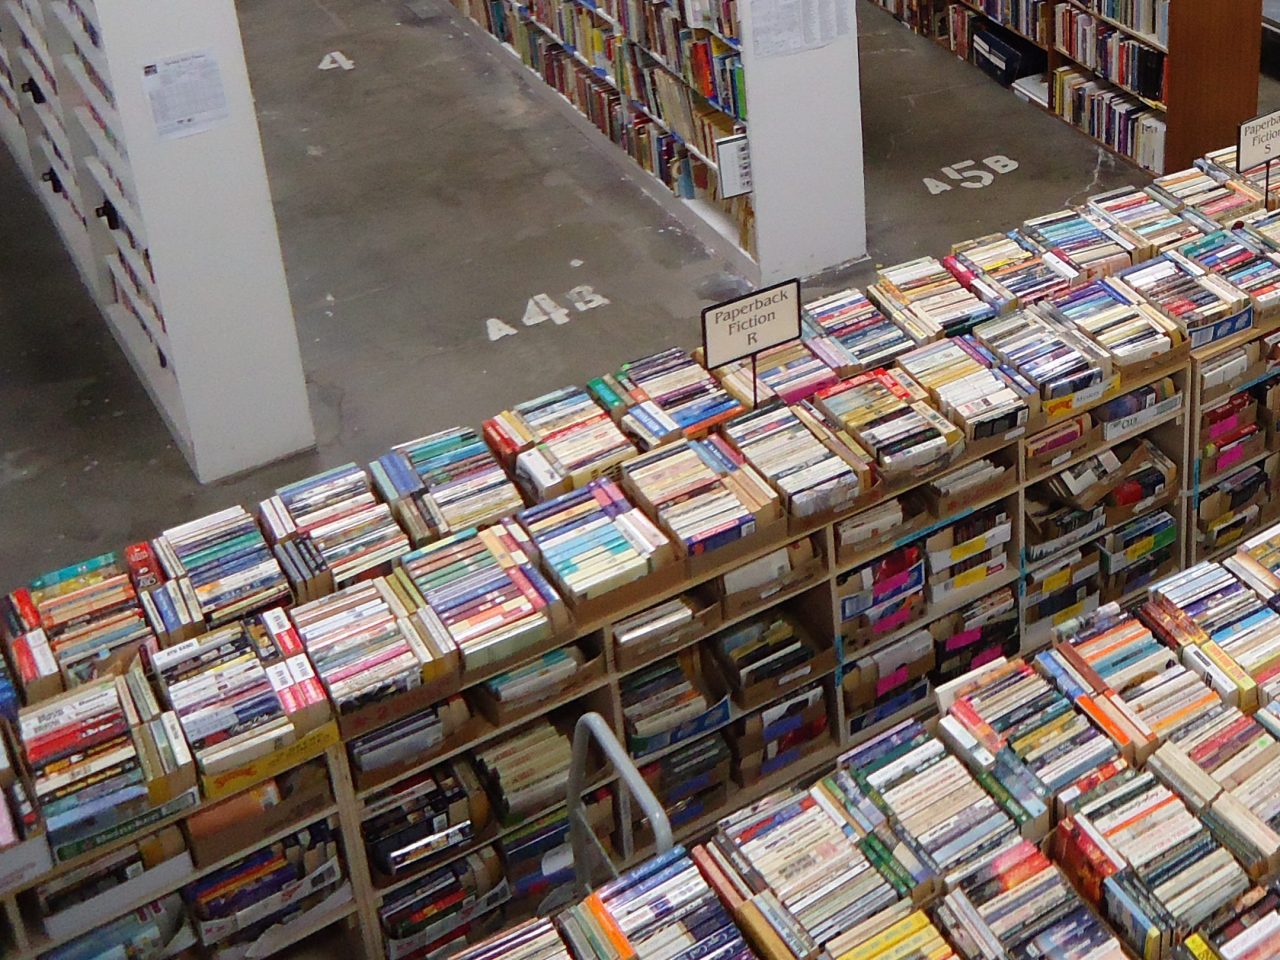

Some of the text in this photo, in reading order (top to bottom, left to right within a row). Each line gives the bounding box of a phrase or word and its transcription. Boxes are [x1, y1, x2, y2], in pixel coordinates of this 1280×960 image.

[1264, 143, 1272, 154] S
[714, 290, 789, 324] Paperback
[728, 311, 776, 336] Fiction
[747, 332, 758, 346] R
